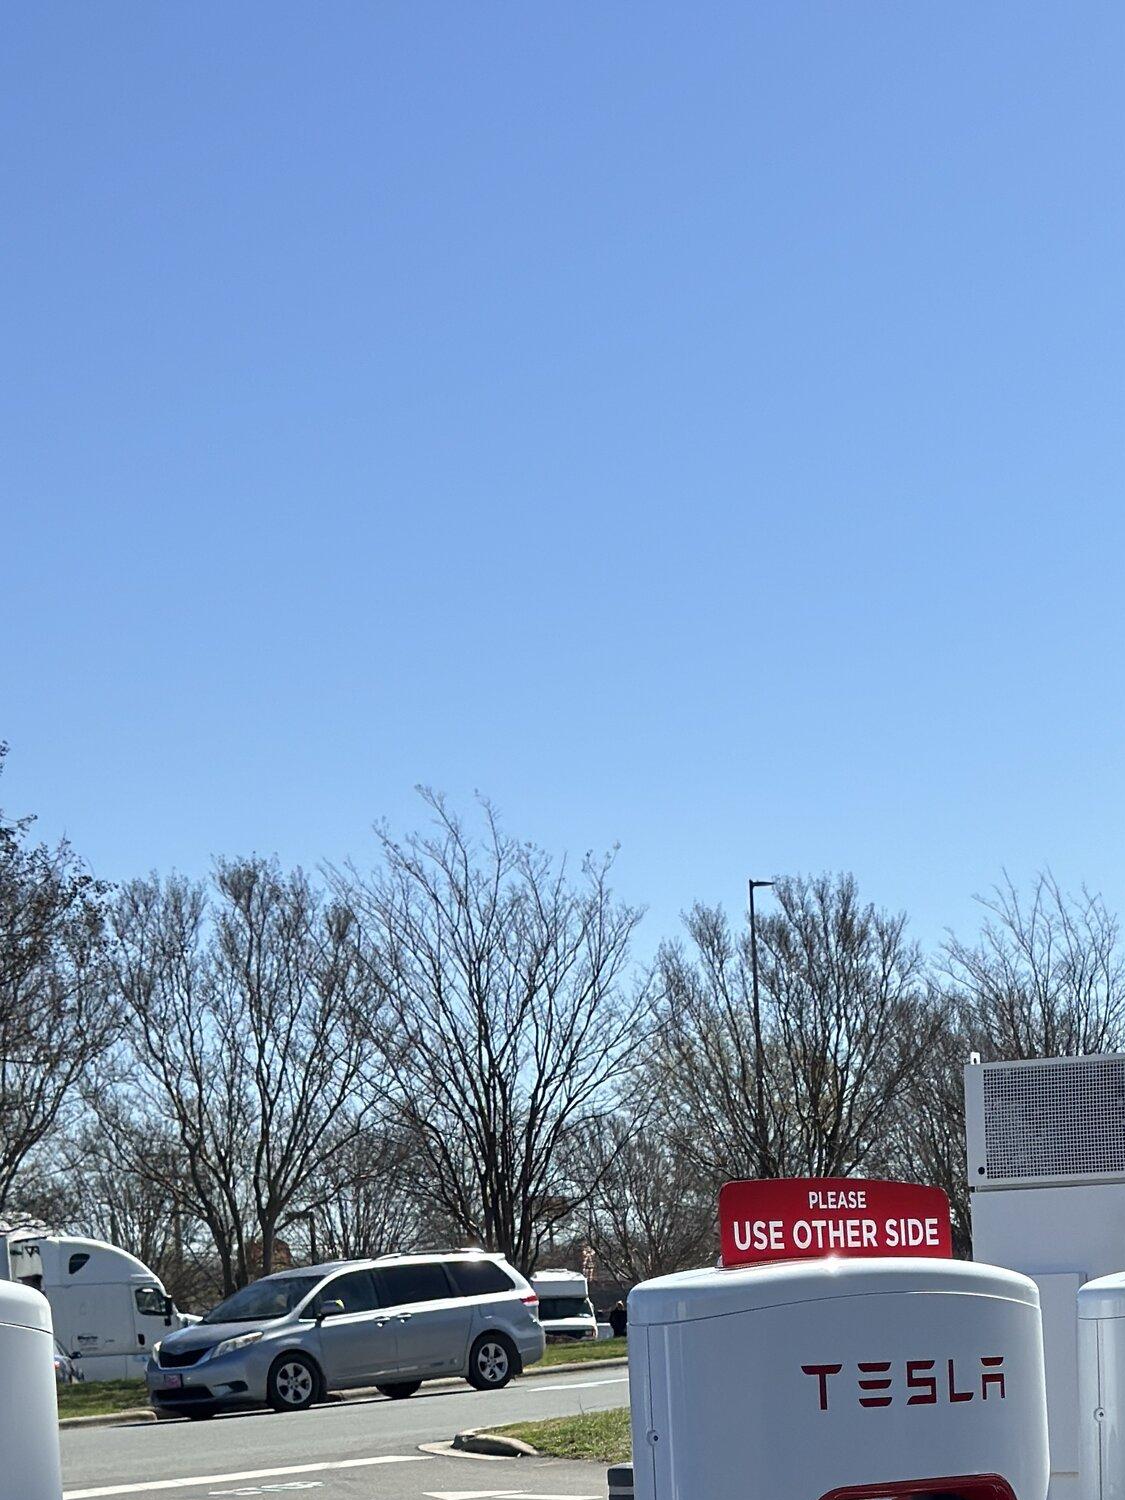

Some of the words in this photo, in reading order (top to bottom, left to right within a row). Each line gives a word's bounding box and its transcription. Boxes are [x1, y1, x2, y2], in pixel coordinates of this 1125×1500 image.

[808, 1191, 867, 1209] PLEASE
[733, 1220, 785, 1250] USE
[792, 1219, 878, 1248] OTHER
[884, 1218, 940, 1246] SIDE
[801, 1356, 1006, 1410] TESLA
